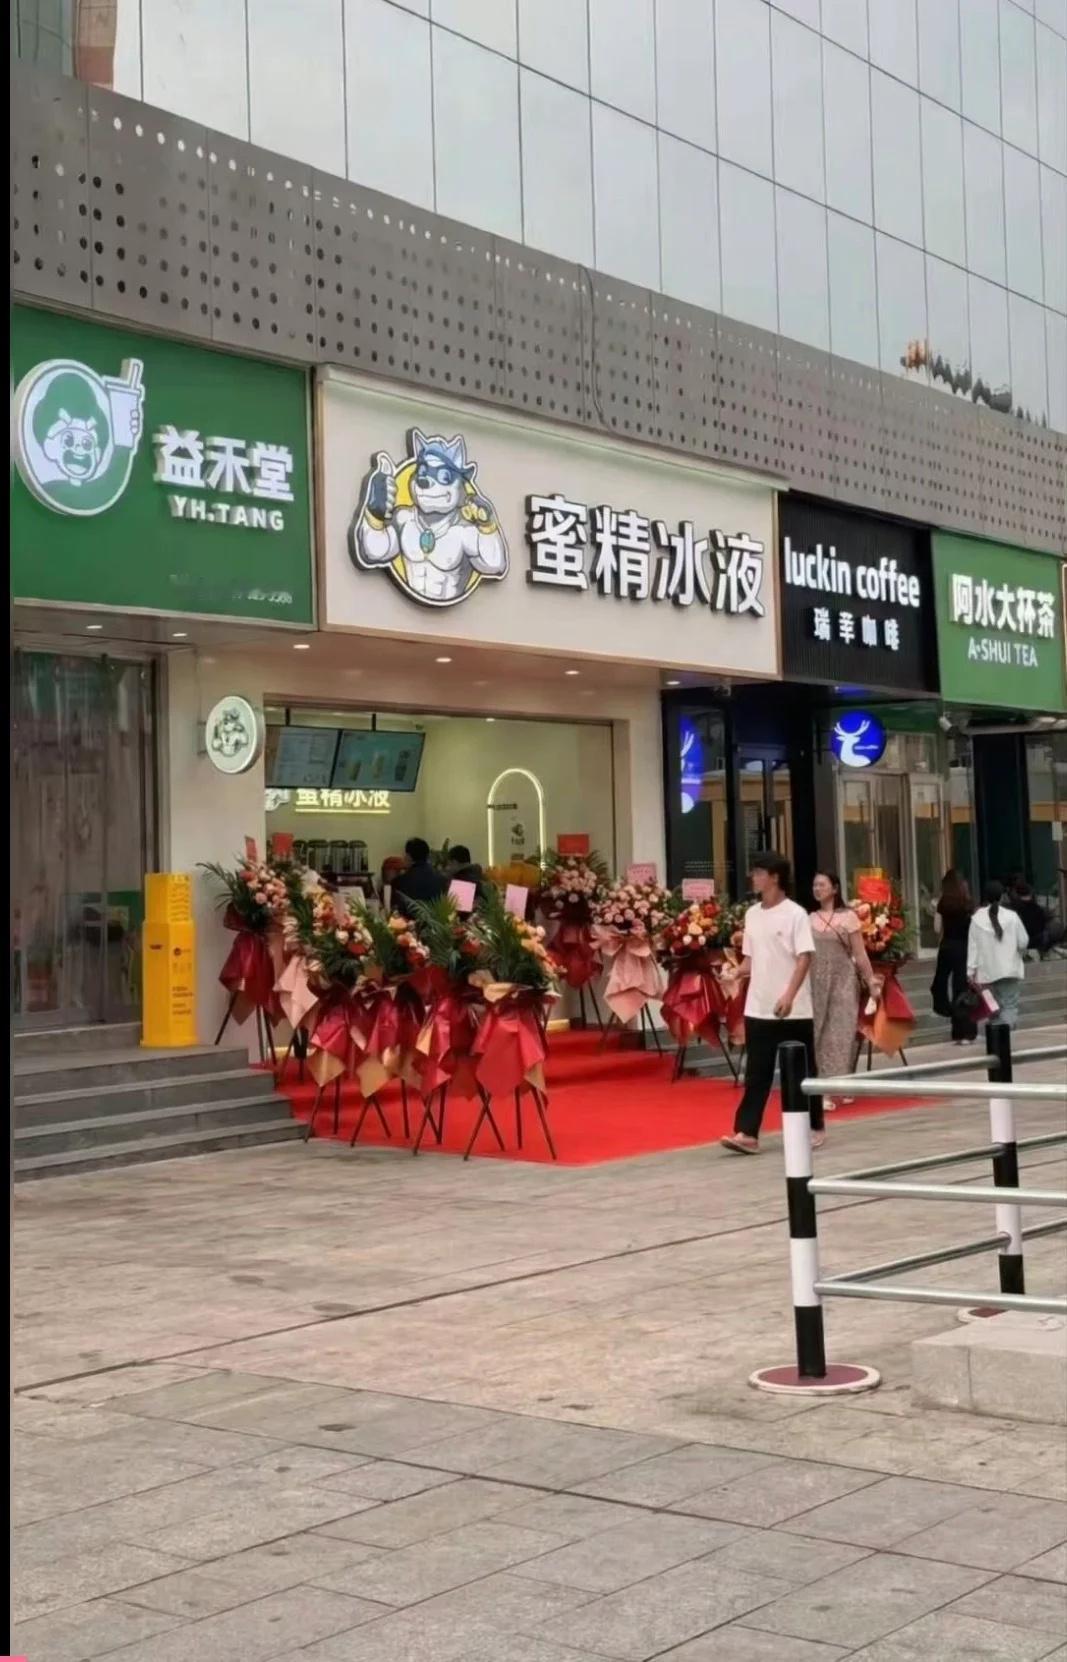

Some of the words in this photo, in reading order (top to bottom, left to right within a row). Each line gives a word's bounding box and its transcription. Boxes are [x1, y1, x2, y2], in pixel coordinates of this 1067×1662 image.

[153, 425, 294, 501] 益禾堂
[169, 495, 285, 530] YH.TANG
[526, 494, 765, 617] 蜜精冰液
[784, 536, 851, 595] luckin
[856, 557, 920, 608] coffee
[813, 607, 900, 651] 瑞幸咖啡
[951, 573, 1055, 639] 阿水大杯茶
[1013, 643, 1038, 667] TEA
